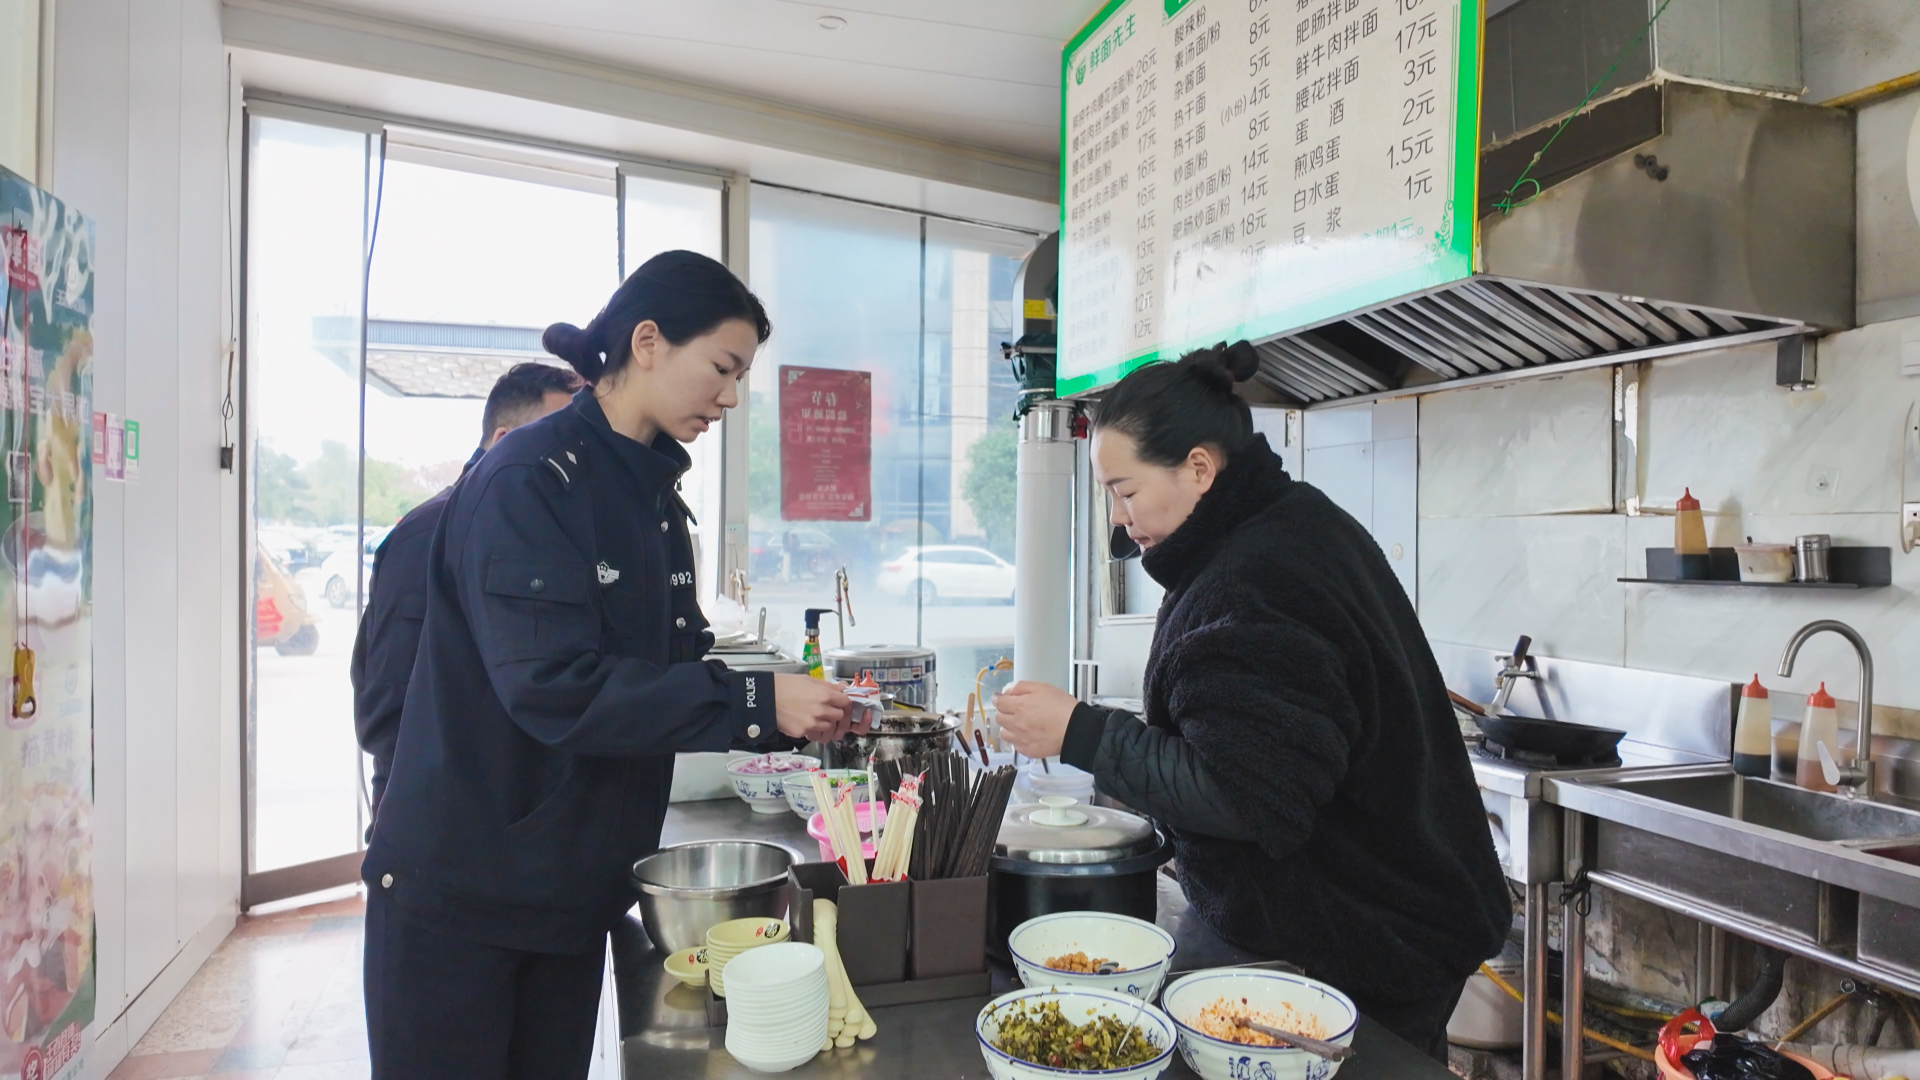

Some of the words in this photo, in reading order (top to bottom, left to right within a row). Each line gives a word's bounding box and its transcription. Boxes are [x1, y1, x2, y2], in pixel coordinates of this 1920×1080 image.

[1090, 13, 1136, 73] 鲜面先生
[1174, 5, 1206, 47] 酸辣粉
[1174, 21, 1220, 72] 素汤面/粉
[1174, 62, 1206, 101] 杂酱面
[1250, 13, 1270, 44] 8元
[1296, 7, 1378, 80] 鲜牛肉拌面
[1136, 48, 1157, 80] 26元
[1296, 55, 1359, 114] 腰花拌面
[1395, 12, 1437, 54] 17元
[1404, 50, 1436, 86] 3元
[1136, 73, 1156, 104] 22元
[1174, 92, 1206, 130] 热干面
[1250, 46, 1270, 77] 5元
[1136, 100, 1156, 130] 22元
[1174, 122, 1206, 158] 热干面
[1250, 78, 1270, 106] 4元
[1138, 128, 1156, 154] 17元
[1174, 150, 1208, 187] 炒面/粉
[1248, 110, 1270, 140] 8元
[1294, 136, 1340, 180] 煎鸡蛋
[1402, 89, 1435, 126] 2元
[1138, 154, 1156, 181] 16元
[1174, 165, 1232, 214] 肉丝炒面/粉
[1242, 143, 1269, 174] 14元
[1294, 172, 1340, 214] 白水蛋
[1387, 128, 1434, 170] 1.5元
[1404, 168, 1433, 200] 1元
[1137, 182, 1156, 208] 16元
[1172, 195, 1231, 241] 肥肠炒面/粉
[1242, 175, 1268, 206] 14元
[1137, 210, 1156, 234] 14元
[1240, 207, 1266, 237] 18元
[1136, 236, 1155, 260] 13元
[1136, 264, 1154, 287] 12元
[1135, 291, 1154, 313] 12元
[1133, 318, 1152, 339] 12元
[746, 676, 757, 708] POLICE
